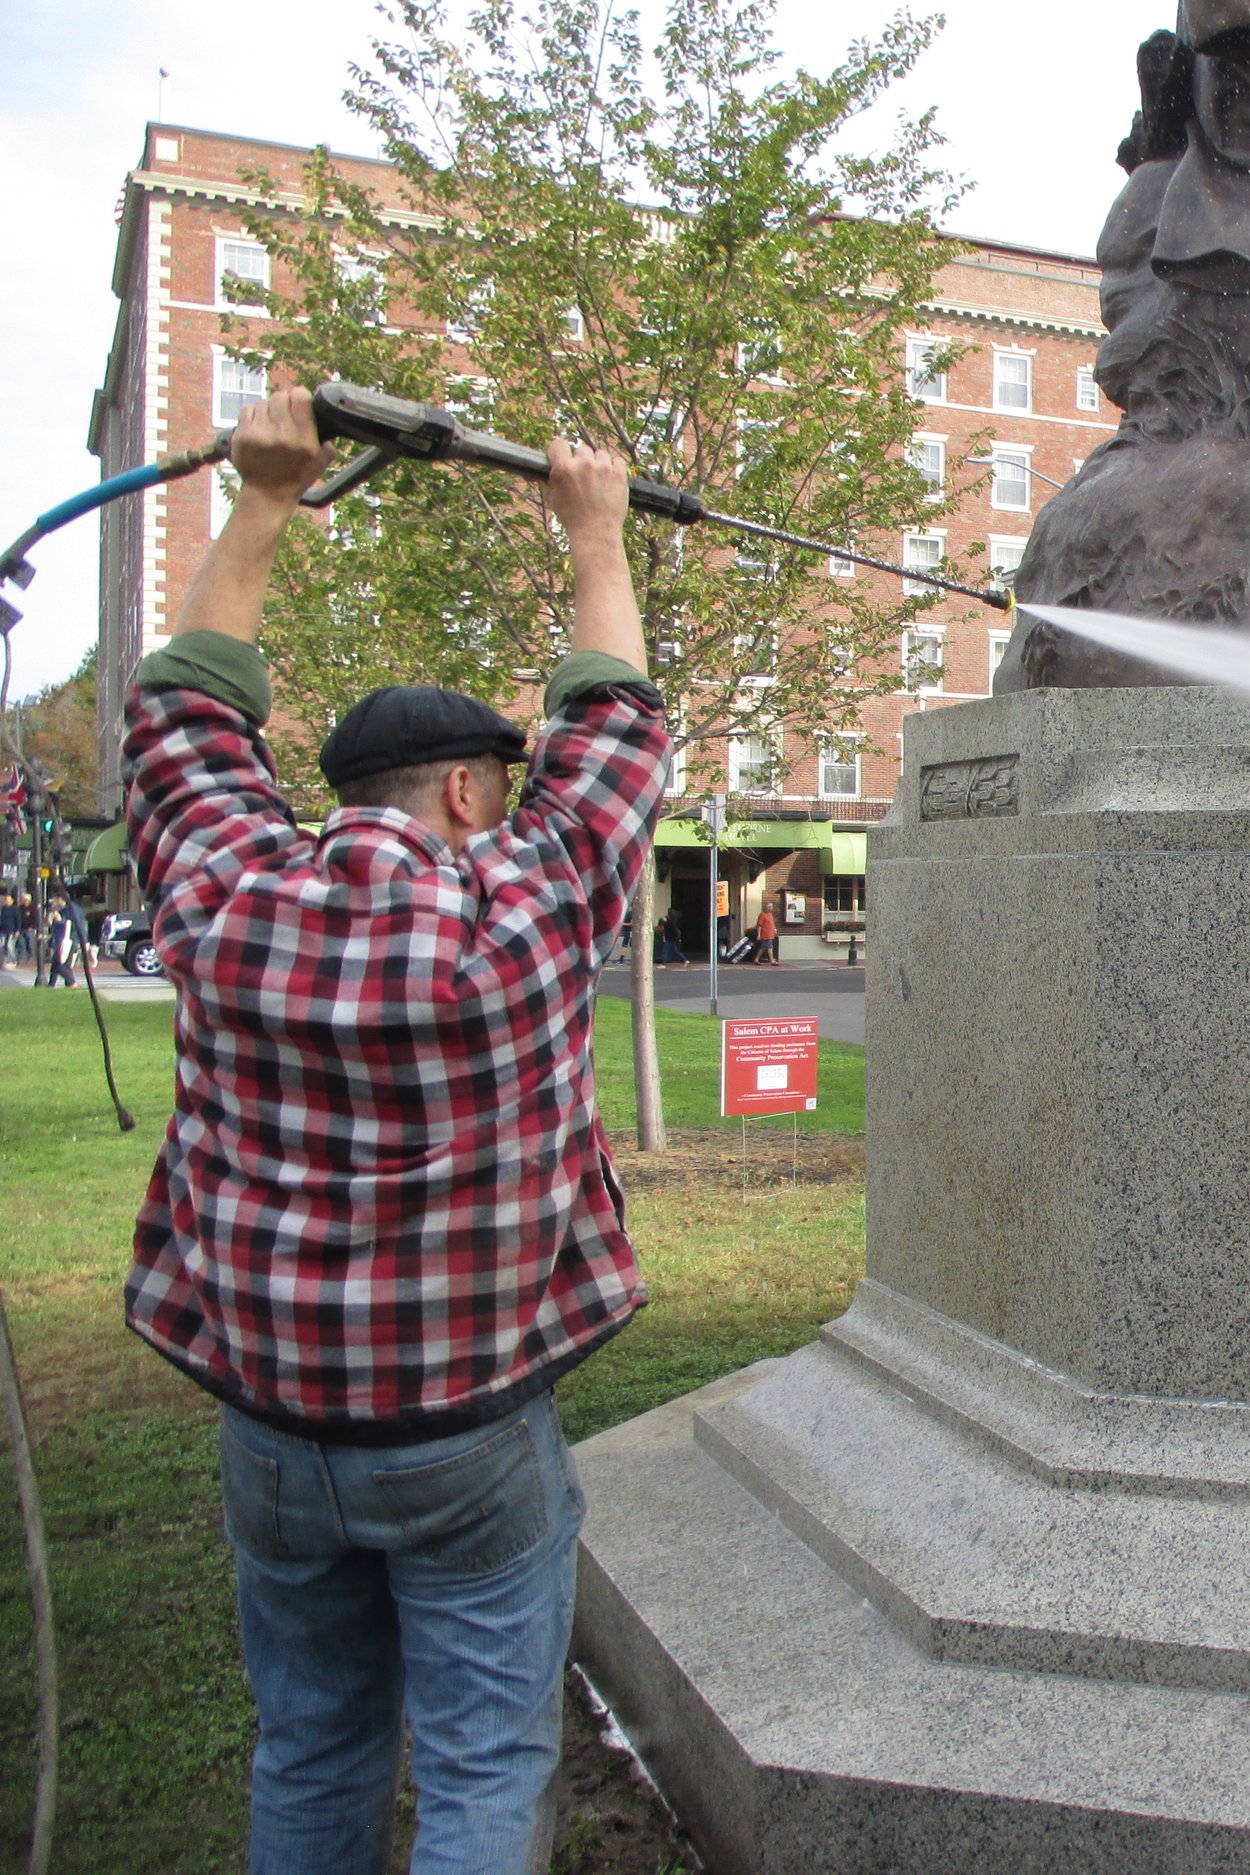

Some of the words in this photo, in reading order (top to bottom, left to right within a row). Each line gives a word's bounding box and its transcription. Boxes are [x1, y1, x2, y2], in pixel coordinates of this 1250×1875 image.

[733, 1027, 758, 1036] Salem
[759, 1025, 779, 1034] CPA
[790, 1024, 812, 1032] Work
